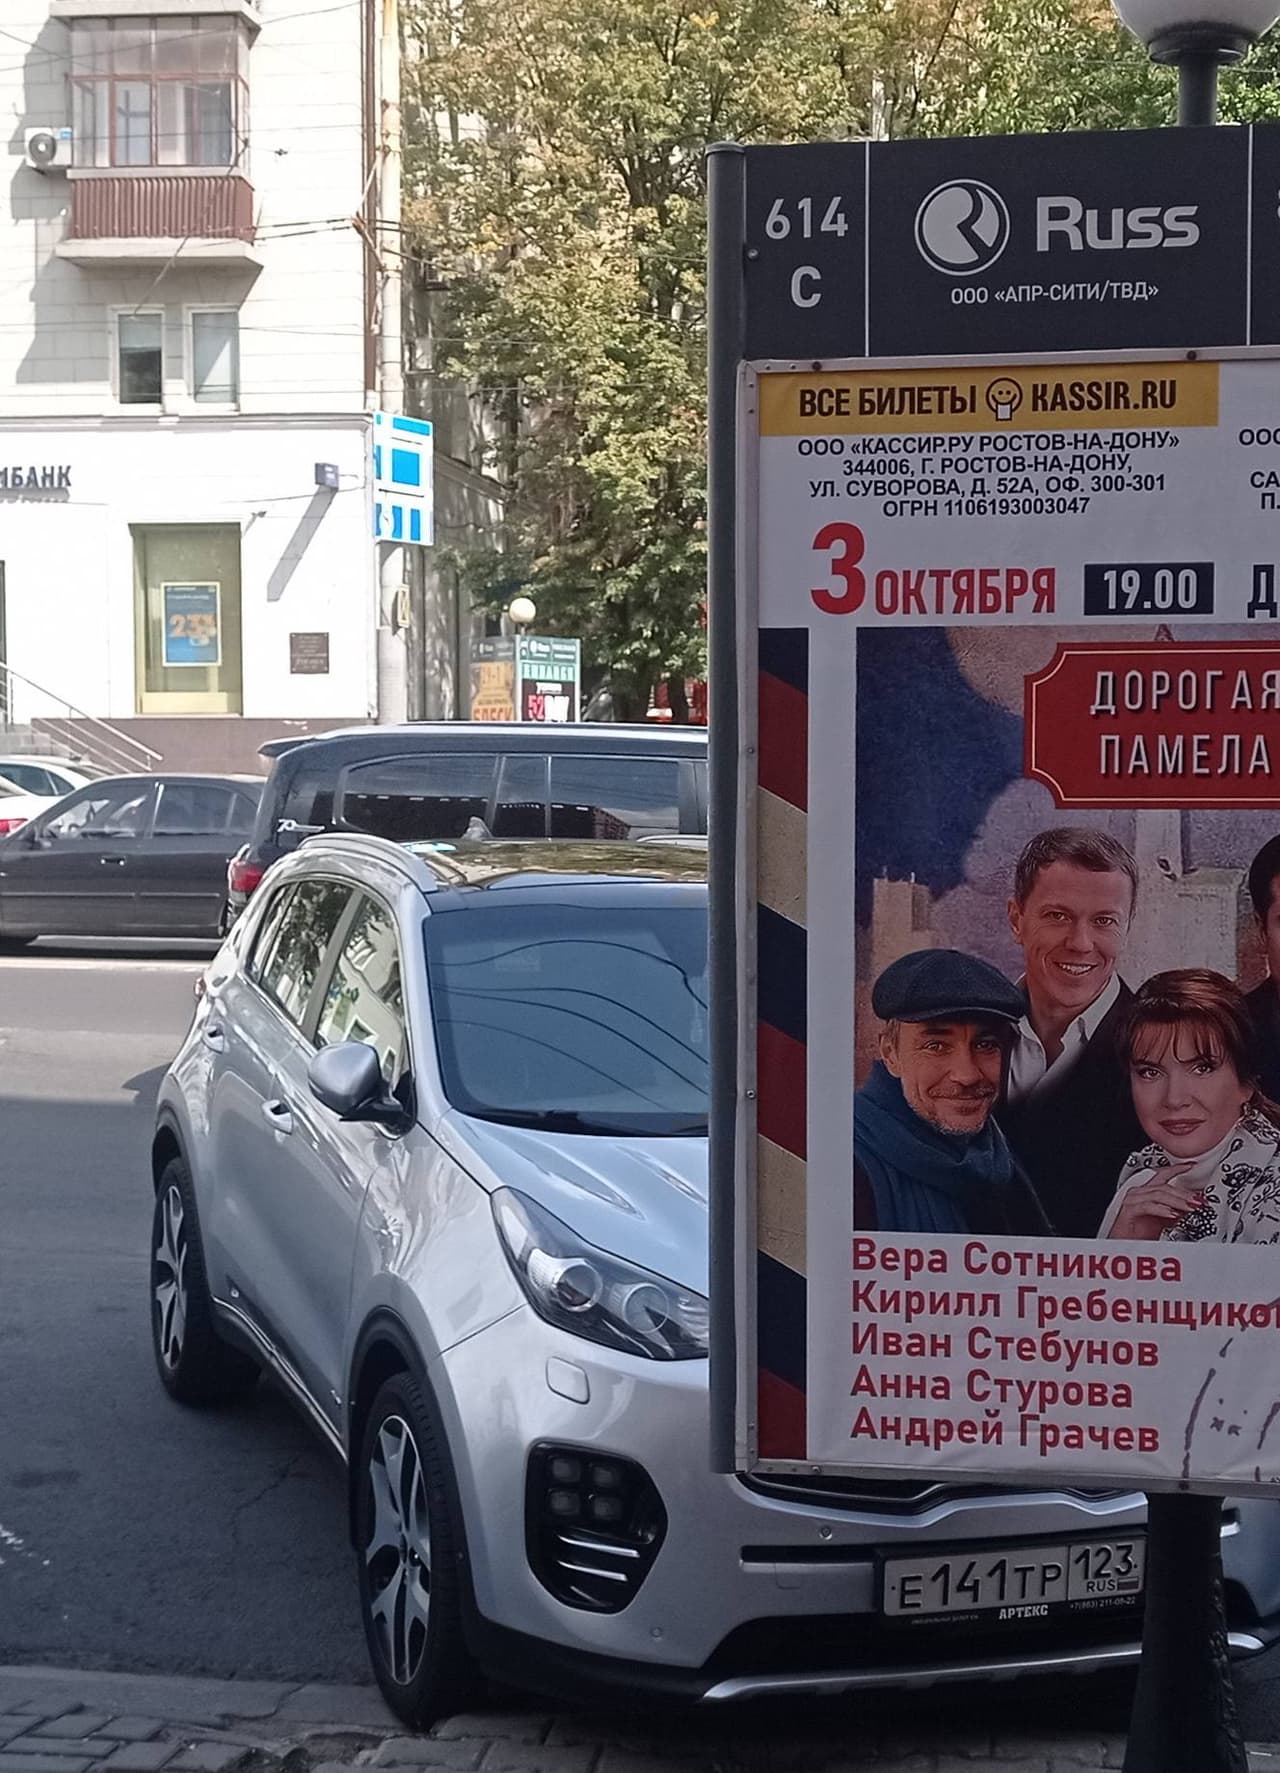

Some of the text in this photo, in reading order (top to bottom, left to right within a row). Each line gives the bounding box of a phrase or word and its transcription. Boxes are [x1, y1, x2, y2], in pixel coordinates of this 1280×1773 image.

[766, 197, 848, 239] 614
[1037, 197, 1199, 251] Russ
[791, 266, 821, 307] С
[952, 280, 1158, 304] ООО «АПР-СИТИ/ТВД»
[800, 385, 976, 416] ВСЕ БИЛЕТЫ
[1032, 380, 1176, 411] KASSIR.RU
[799, 431, 1179, 455] ООО «КАССИР.РУ РОСТОВ-НА-ДОНУ»
[843, 453, 1131, 477] 344006, Г. РОСТОВ-НА-ДОНУ,
[810, 474, 1164, 497] УЛ. СУВОРОВА, Д. 52А, ОФ. 300-301
[1261, 493, 1280, 509] П.
[883, 497, 1090, 517] ОГРН 1106193003047
[811, 523, 1055, 615] 3 ОКТЯБРЯ
[1104, 569, 1196, 609] 19.00
[1090, 670, 1280, 715] ДОРОГАЯ
[1101, 735, 1269, 773] ПАМЕЛА
[853, 1238, 1181, 1281] Вера Сотникова
[853, 1280, 1000, 1321] Кирилл
[853, 1322, 1158, 1372] Иван Стебунов
[850, 1365, 1132, 1415] Анна Стурова
[850, 1407, 1159, 1456] Андрей Грачев
[899, 1544, 1134, 1609] Е141ТР 123
[1086, 1579, 1115, 1593] RUS
[999, 1604, 1049, 1620] АРТЕКС
